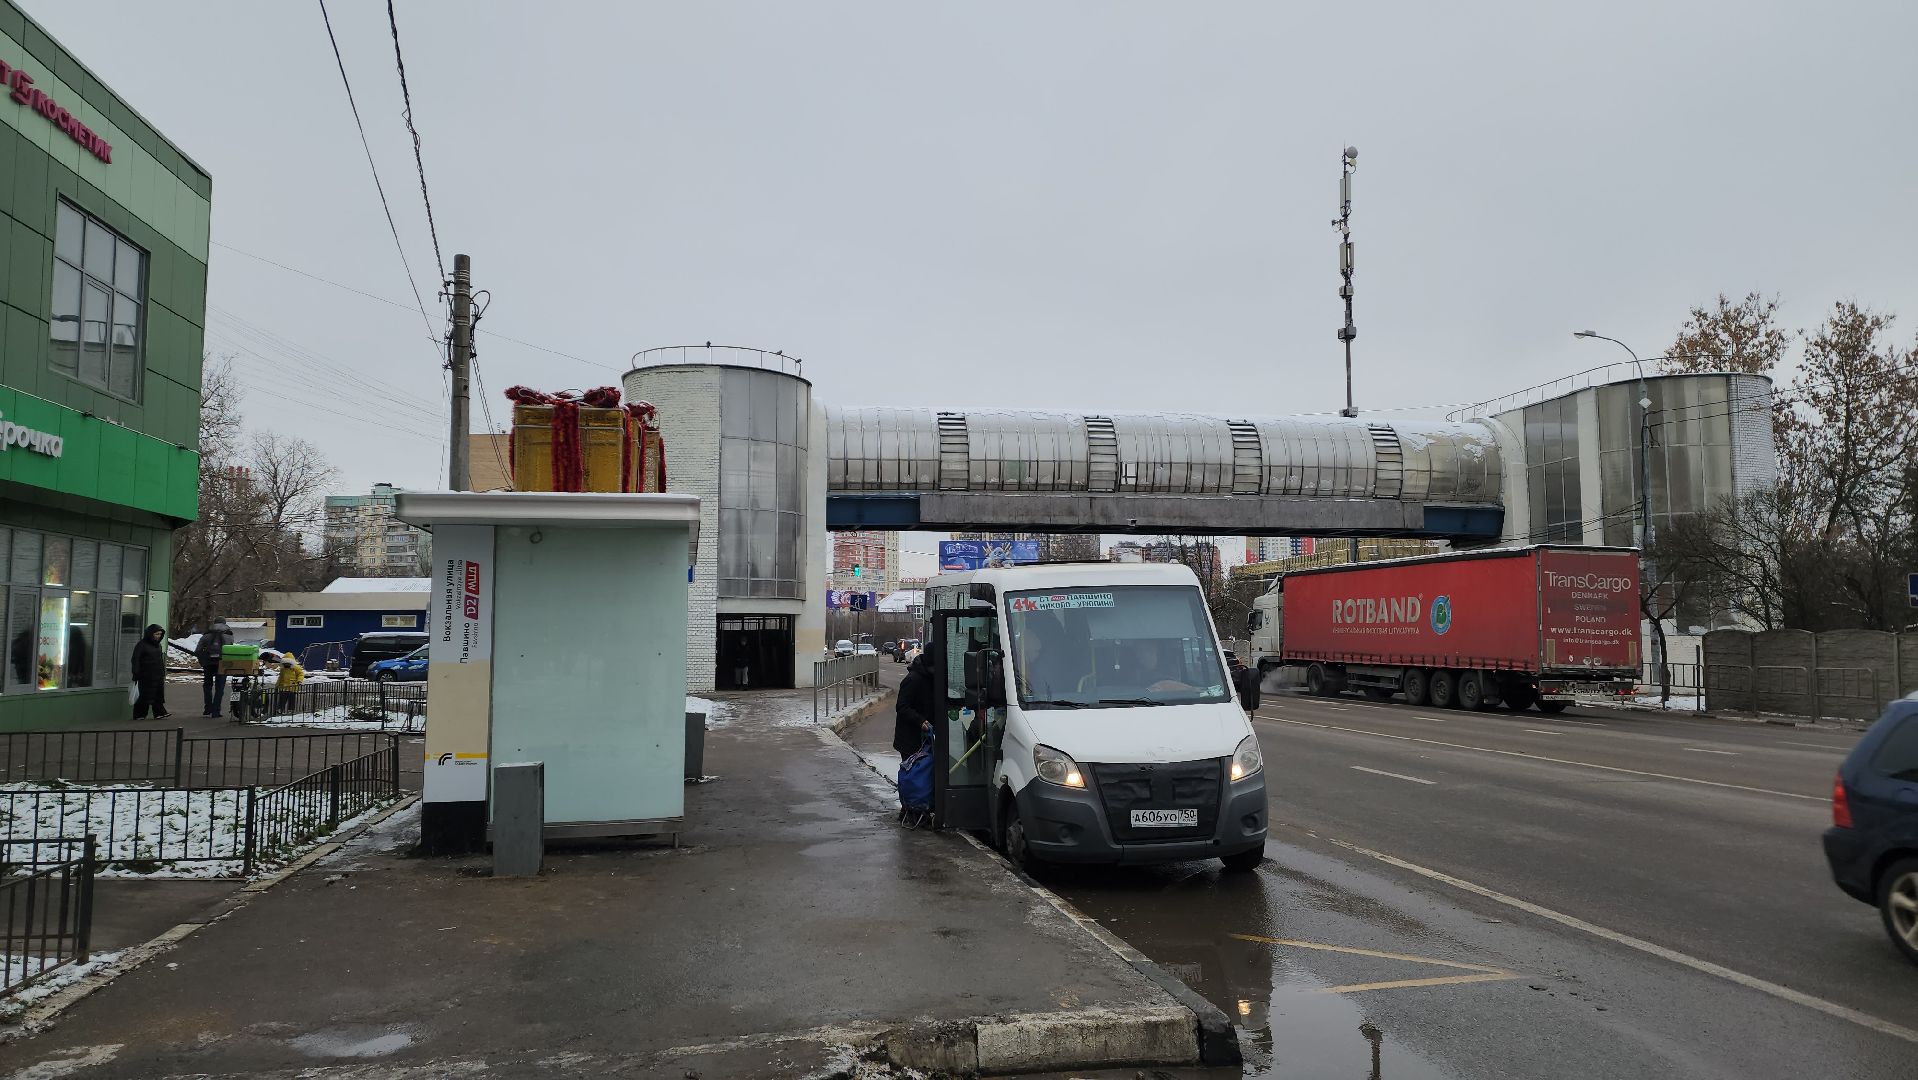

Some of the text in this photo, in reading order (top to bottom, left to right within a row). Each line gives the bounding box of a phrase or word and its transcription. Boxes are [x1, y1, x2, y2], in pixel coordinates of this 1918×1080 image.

[32, 88, 112, 164] КОСМЕТИК
[0, 411, 63, 457] рочка
[1544, 571, 1631, 592] TransCargo
[1571, 591, 1608, 599] DENMARK
[443, 560, 455, 641] Вокзальная улица
[1332, 597, 1420, 624] ROTBAND
[460, 566, 477, 664] Павшино D2 МЦД
[1575, 615, 1606, 623] POLAND
[1550, 627, 1632, 637] www.transcargo.dk
